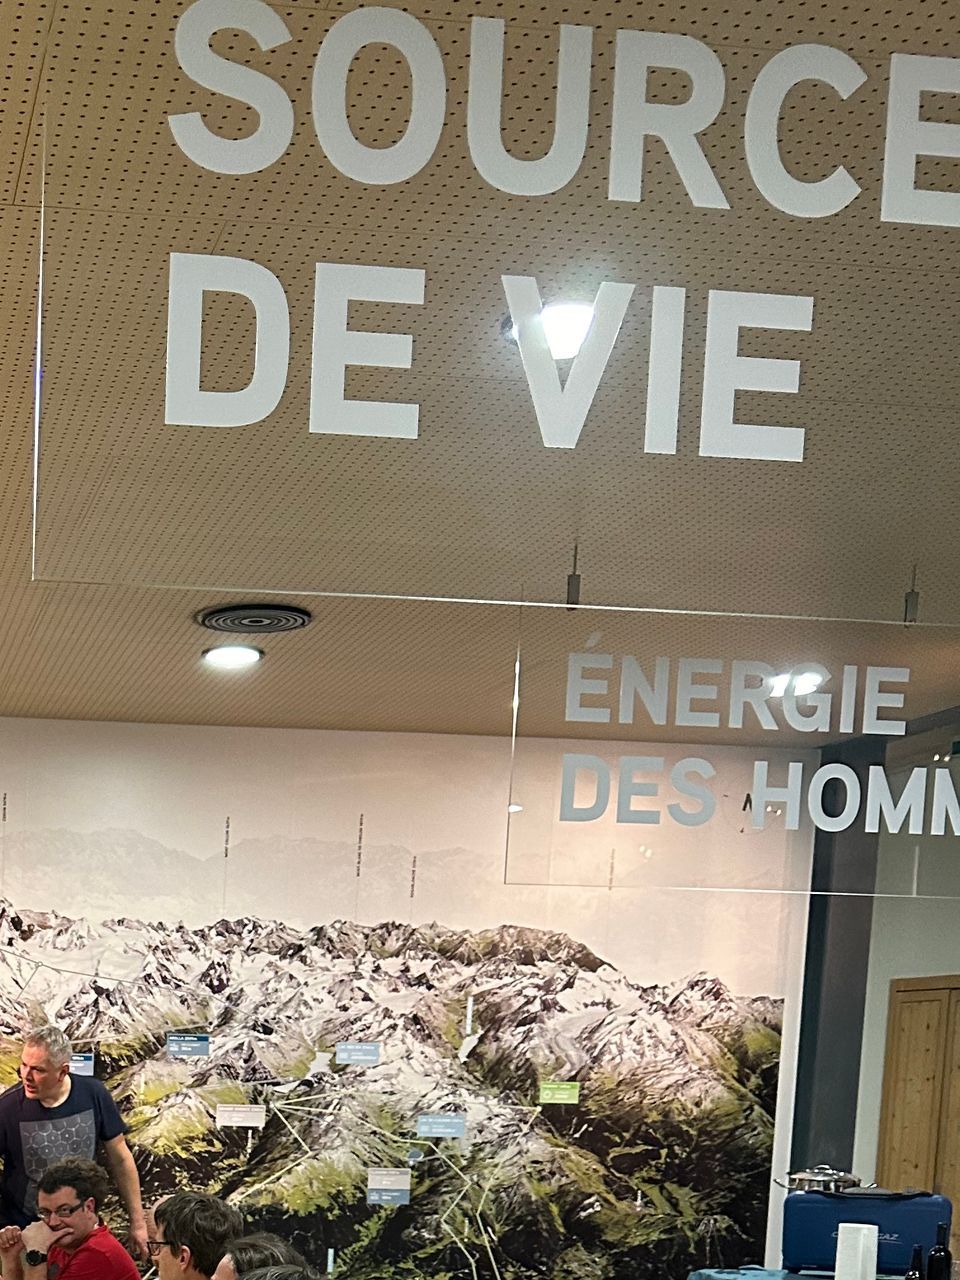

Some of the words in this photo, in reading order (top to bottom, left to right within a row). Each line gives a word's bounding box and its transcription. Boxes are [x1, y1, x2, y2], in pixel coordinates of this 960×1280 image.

[167, 0, 960, 227] SOURCE
[165, 252, 426, 440] DE
[501, 275, 815, 463] VIE
[565, 632, 911, 735] ÉNERGIE
[559, 753, 717, 827] DES
